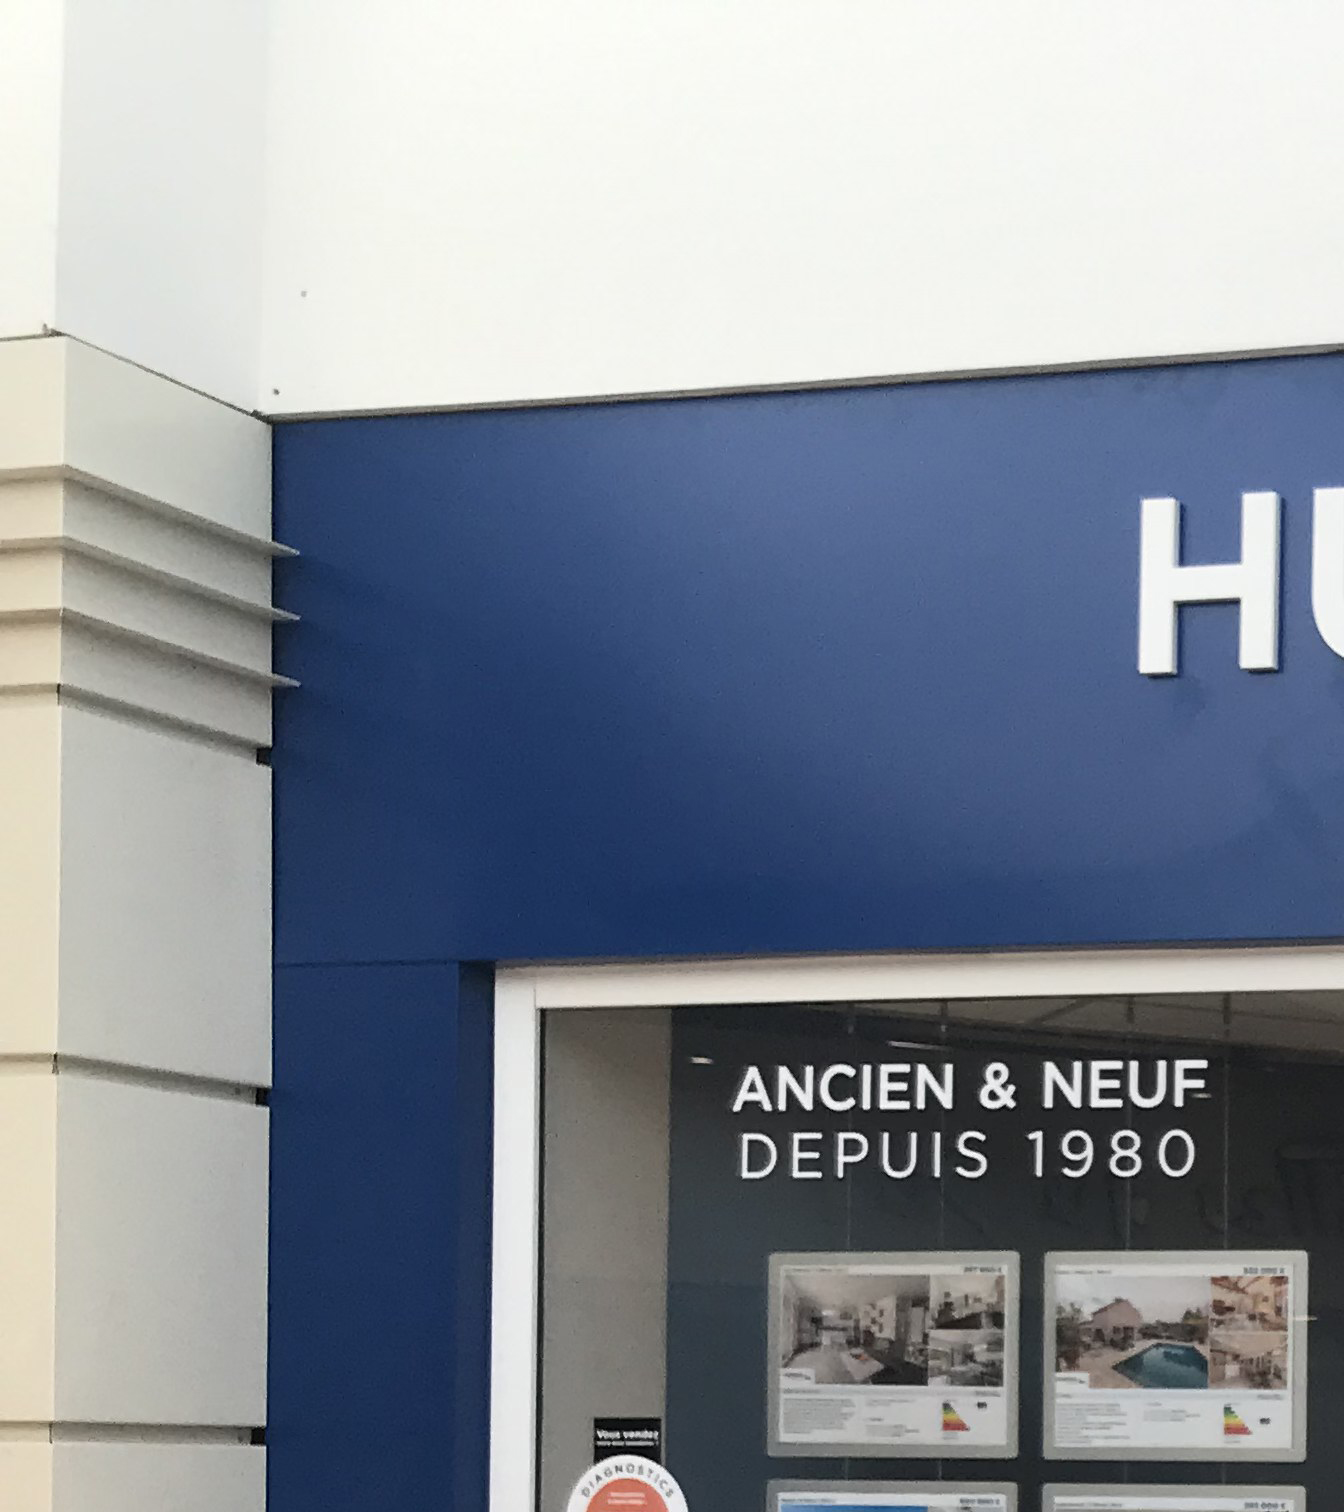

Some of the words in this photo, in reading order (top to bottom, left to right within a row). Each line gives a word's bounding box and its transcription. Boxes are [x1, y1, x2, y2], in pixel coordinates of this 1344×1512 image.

[732, 1061, 955, 1112] ANCIEN
[978, 1060, 1018, 1110] &
[1044, 1059, 1208, 1109] NEUF
[740, 1130, 989, 1180] DEPUIS
[1026, 1128, 1197, 1178] 1980
[581, 1463, 674, 1498] DIAGNOSTICS
